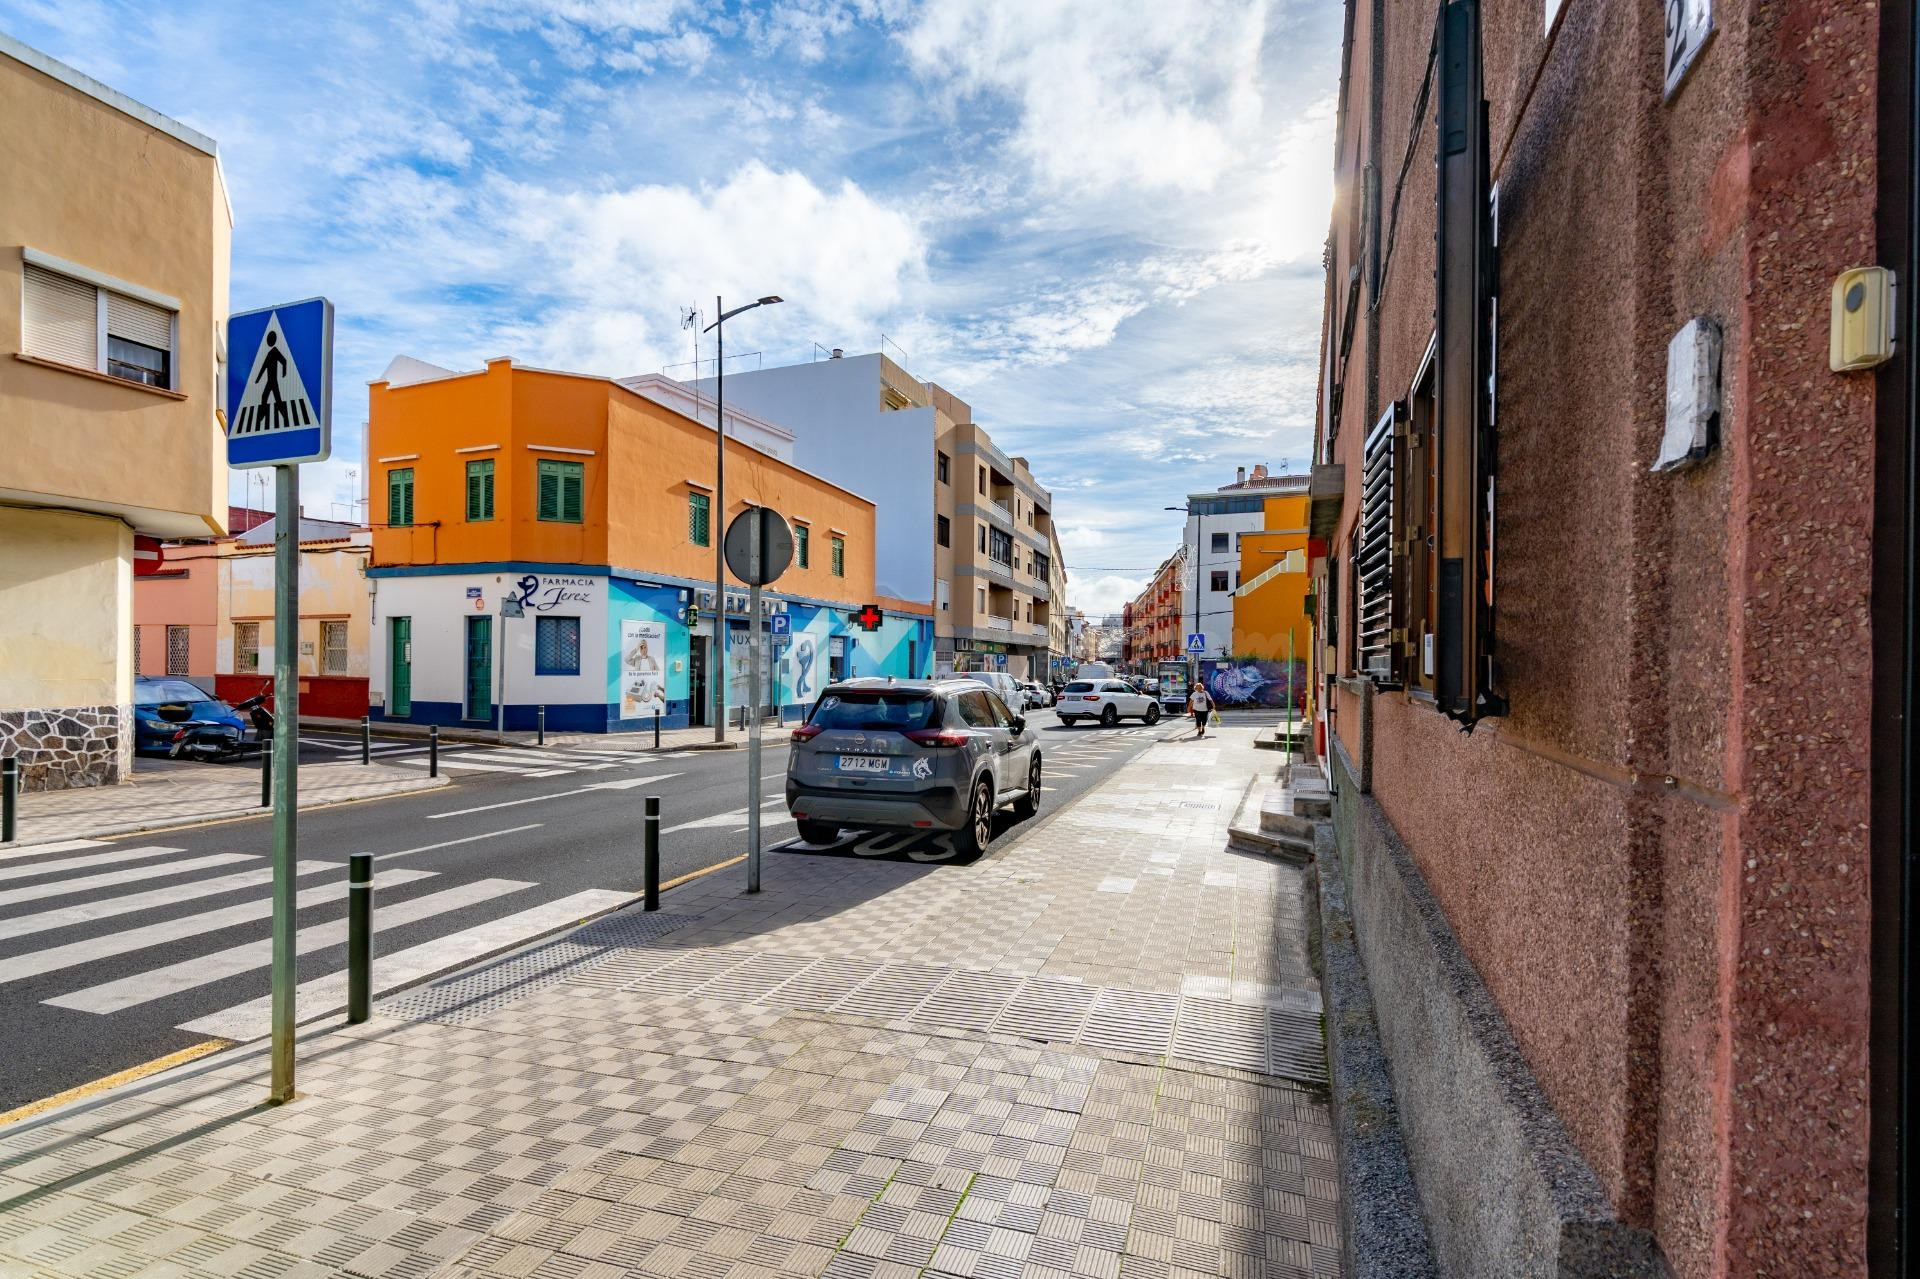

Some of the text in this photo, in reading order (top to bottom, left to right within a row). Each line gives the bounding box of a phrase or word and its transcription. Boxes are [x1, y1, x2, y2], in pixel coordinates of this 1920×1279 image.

[542, 577, 595, 586] FARMACIA
[536, 587, 592, 611] Jerez
[775, 617, 787, 633] P
[841, 757, 888, 769] 2712 MGM
